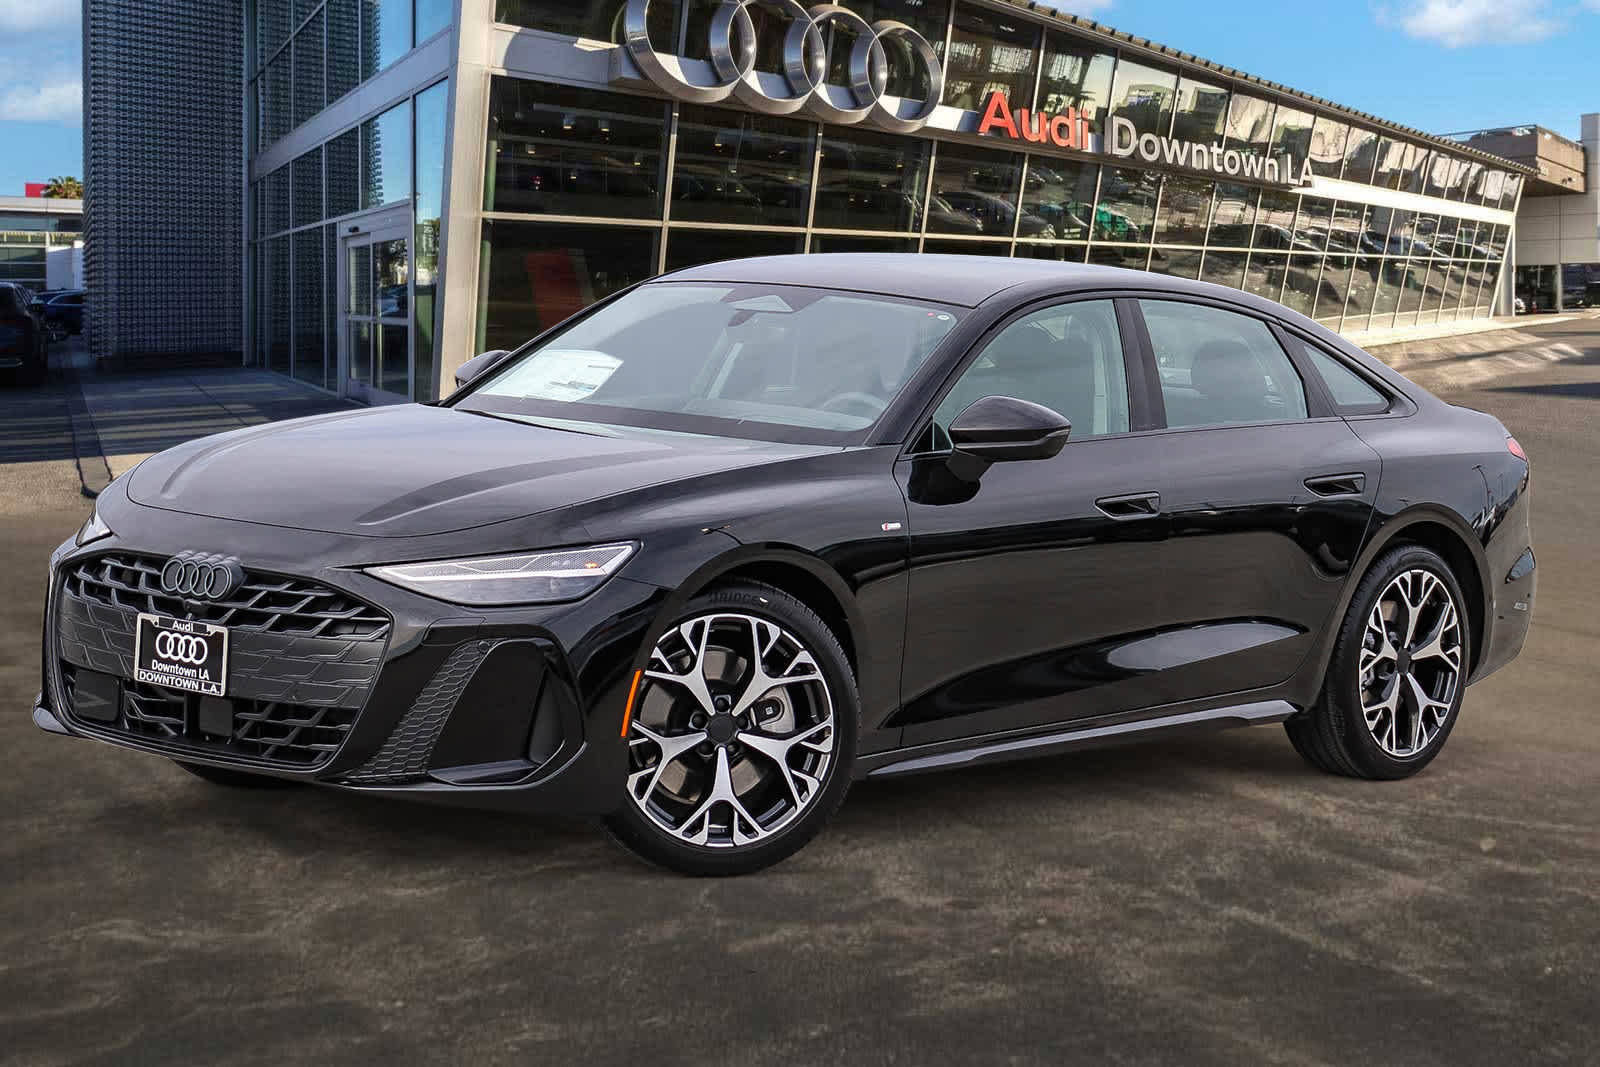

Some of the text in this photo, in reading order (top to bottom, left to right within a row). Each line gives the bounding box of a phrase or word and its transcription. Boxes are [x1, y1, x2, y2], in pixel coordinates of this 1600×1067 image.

[978, 91, 1313, 187] Audi Downtown LA
[172, 620, 194, 632] Audi
[151, 659, 210, 681] Downtown LA
[139, 671, 221, 694] DOWNTOWN L.A.
